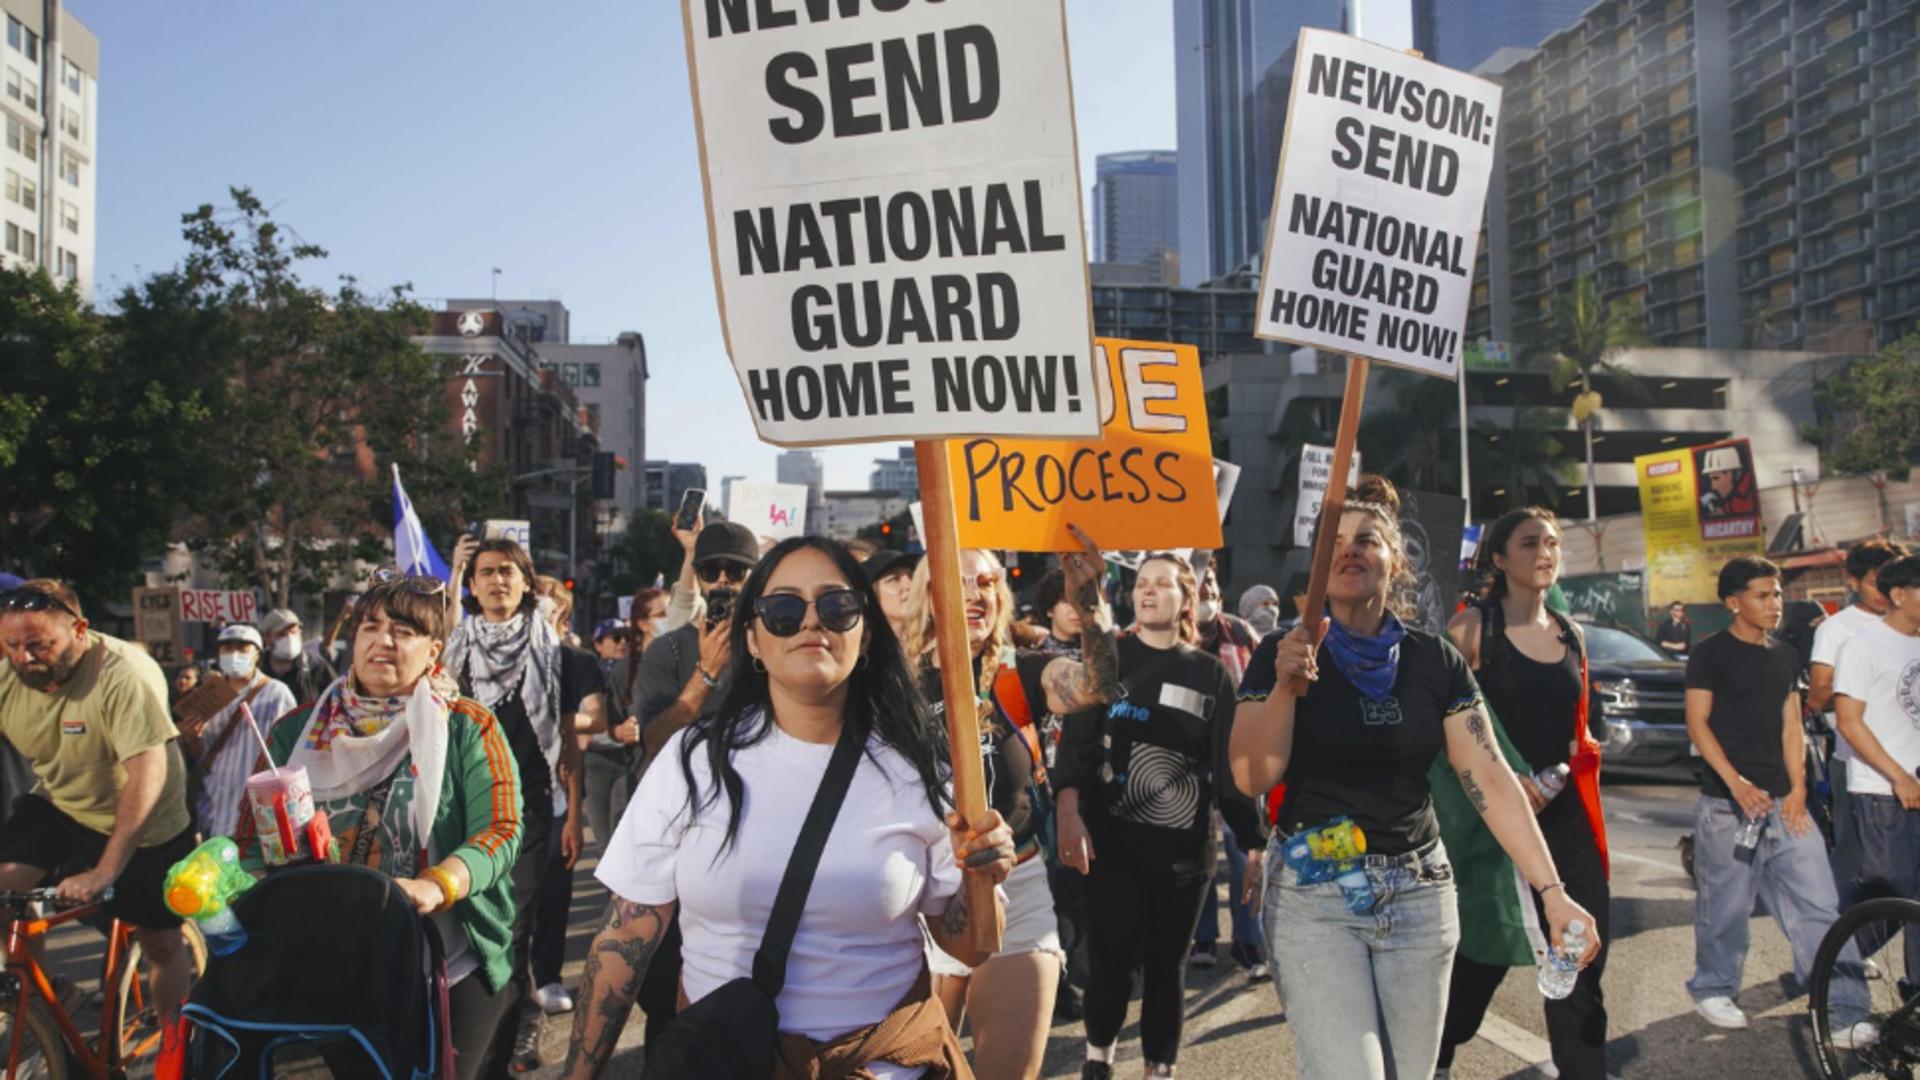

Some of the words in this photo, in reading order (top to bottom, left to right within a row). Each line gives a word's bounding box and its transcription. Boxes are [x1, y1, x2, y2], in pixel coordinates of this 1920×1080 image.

[765, 24, 1000, 145] SEND
[1307, 53, 1494, 145] NEWSOM:
[1331, 116, 1460, 197] SEND
[733, 179, 1066, 276] NATIONAL
[1288, 193, 1467, 277] NATIONAL
[791, 271, 1020, 352] GUARD
[1311, 248, 1439, 316] GUARD
[1269, 288, 1369, 342] HOME
[1376, 313, 1458, 363] NOW!
[748, 359, 914, 421] HOME
[931, 355, 1082, 413] NOW!
[964, 438, 1187, 522] PROCESS
[182, 590, 224, 621] RISE
[229, 591, 257, 622] UP
